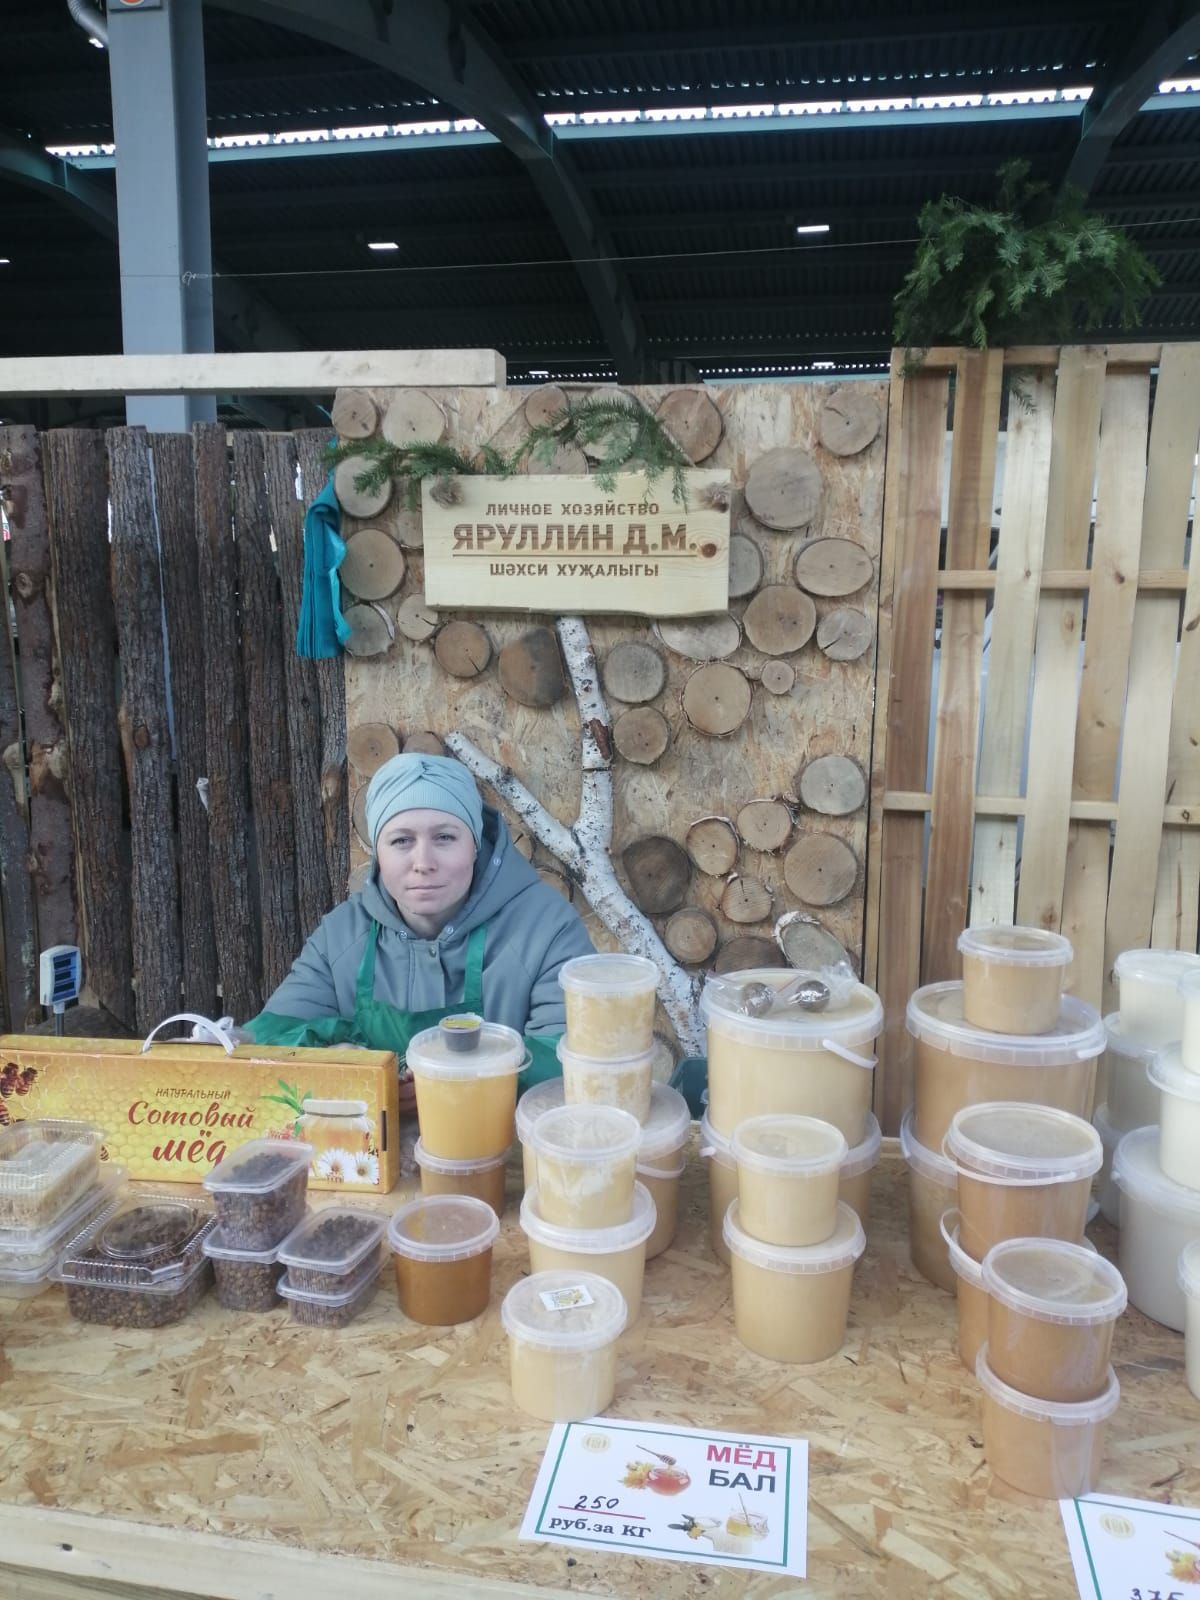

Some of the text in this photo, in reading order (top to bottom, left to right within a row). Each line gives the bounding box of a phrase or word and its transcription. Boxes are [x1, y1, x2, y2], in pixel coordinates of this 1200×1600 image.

[485, 500, 660, 517] ЛИЧНОЕ ХОЗЯЙСТВО
[452, 523, 698, 555] ЯРУЛЛИН Д.М.
[489, 563, 659, 579] ШӘХСИ ХУҖАЛЫГЫ
[155, 1087, 231, 1100] НАТУРАЛЬНЫЙ
[128, 1100, 256, 1128] Сотовый
[706, 1443, 777, 1472] МЁД
[708, 1468, 776, 1493] БАЛ
[574, 1495, 620, 1510] 250
